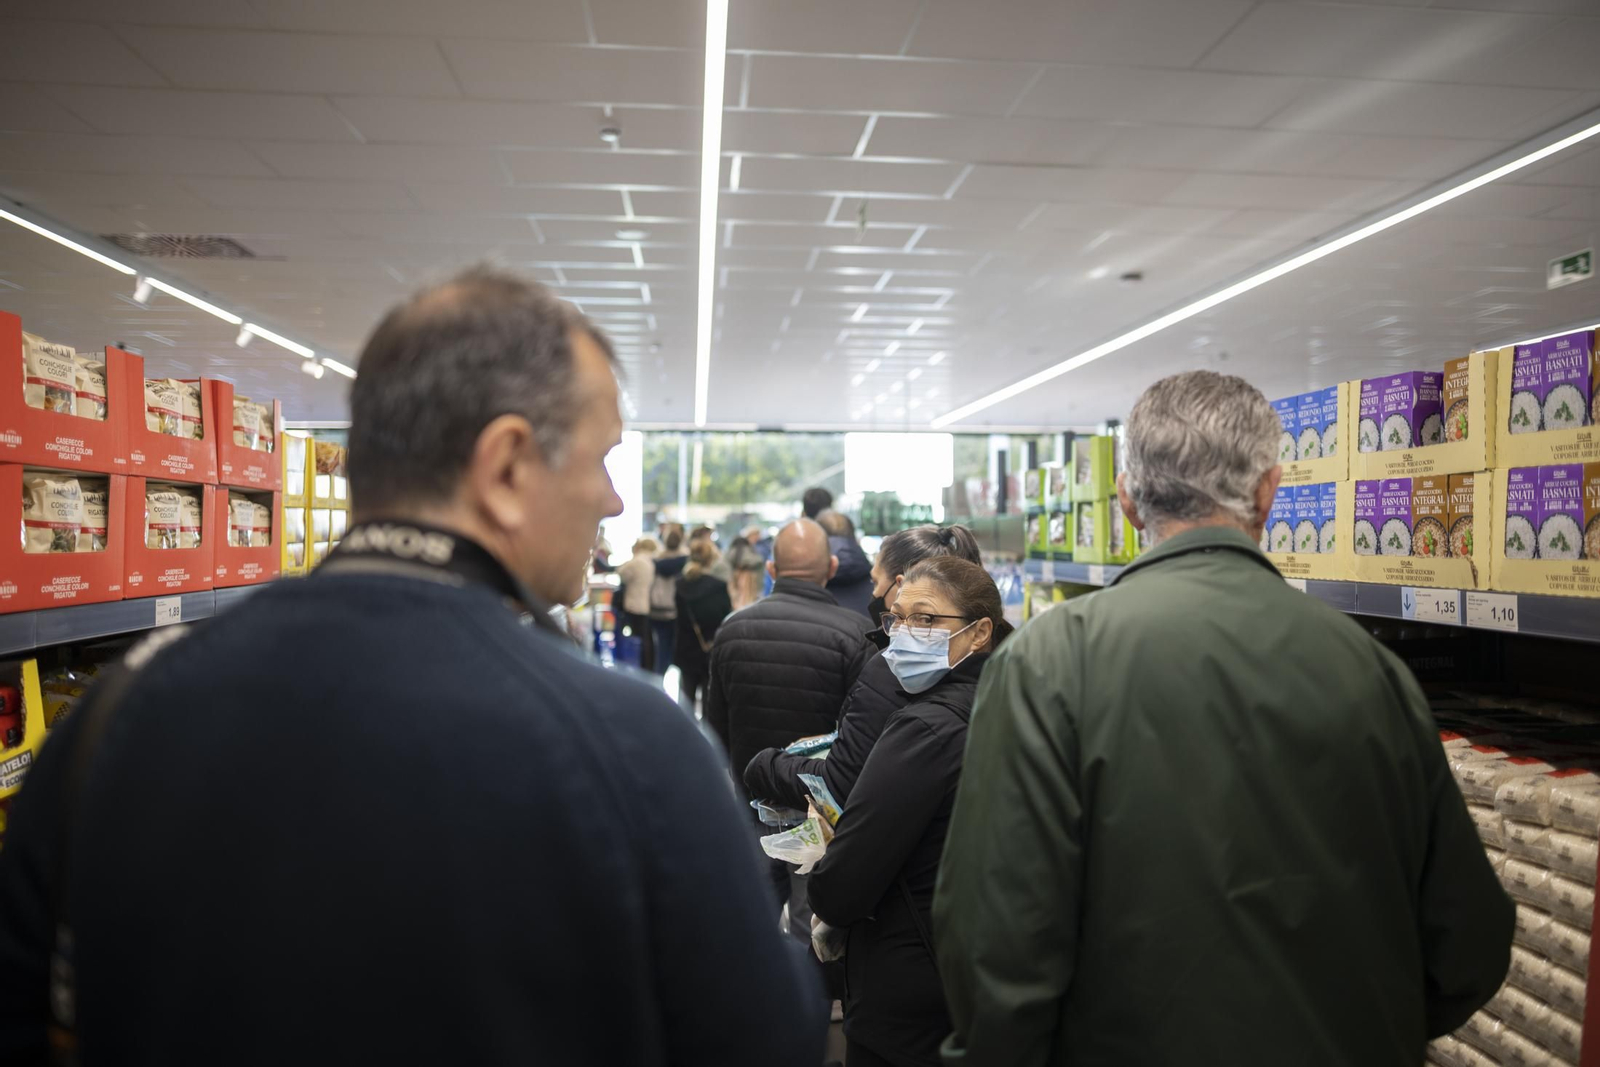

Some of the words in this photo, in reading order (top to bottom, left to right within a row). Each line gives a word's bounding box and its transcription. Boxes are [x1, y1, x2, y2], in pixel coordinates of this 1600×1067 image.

[39, 358, 72, 373] CONCHIGLIE
[1546, 354, 1582, 371] BASMATI
[48, 367, 68, 378] COLORI
[1548, 373, 1551, 382] 1
[1384, 391, 1410, 403] BASMATI
[1298, 407, 1321, 418] REDONDO
[56, 436, 84, 448] CASERECCE
[45, 442, 76, 454] CONCHIGLIE
[76, 447, 93, 456] COLORI
[58, 452, 81, 462] RIGATONI
[1542, 487, 1580, 499] BASMATI
[1295, 501, 1318, 510] REDONDO
[1382, 497, 1409, 506] BASMATI
[1413, 496, 1445, 505] INTEGRAL
[1545, 501, 1548, 510] 1
[52, 576, 81, 585] CASERECCE
[41, 584, 71, 593] CONCHIGLIE
[54, 591, 76, 600] RIGATONI
[1435, 600, 1455, 614] 1,35
[1491, 607, 1514, 622] 1,10
